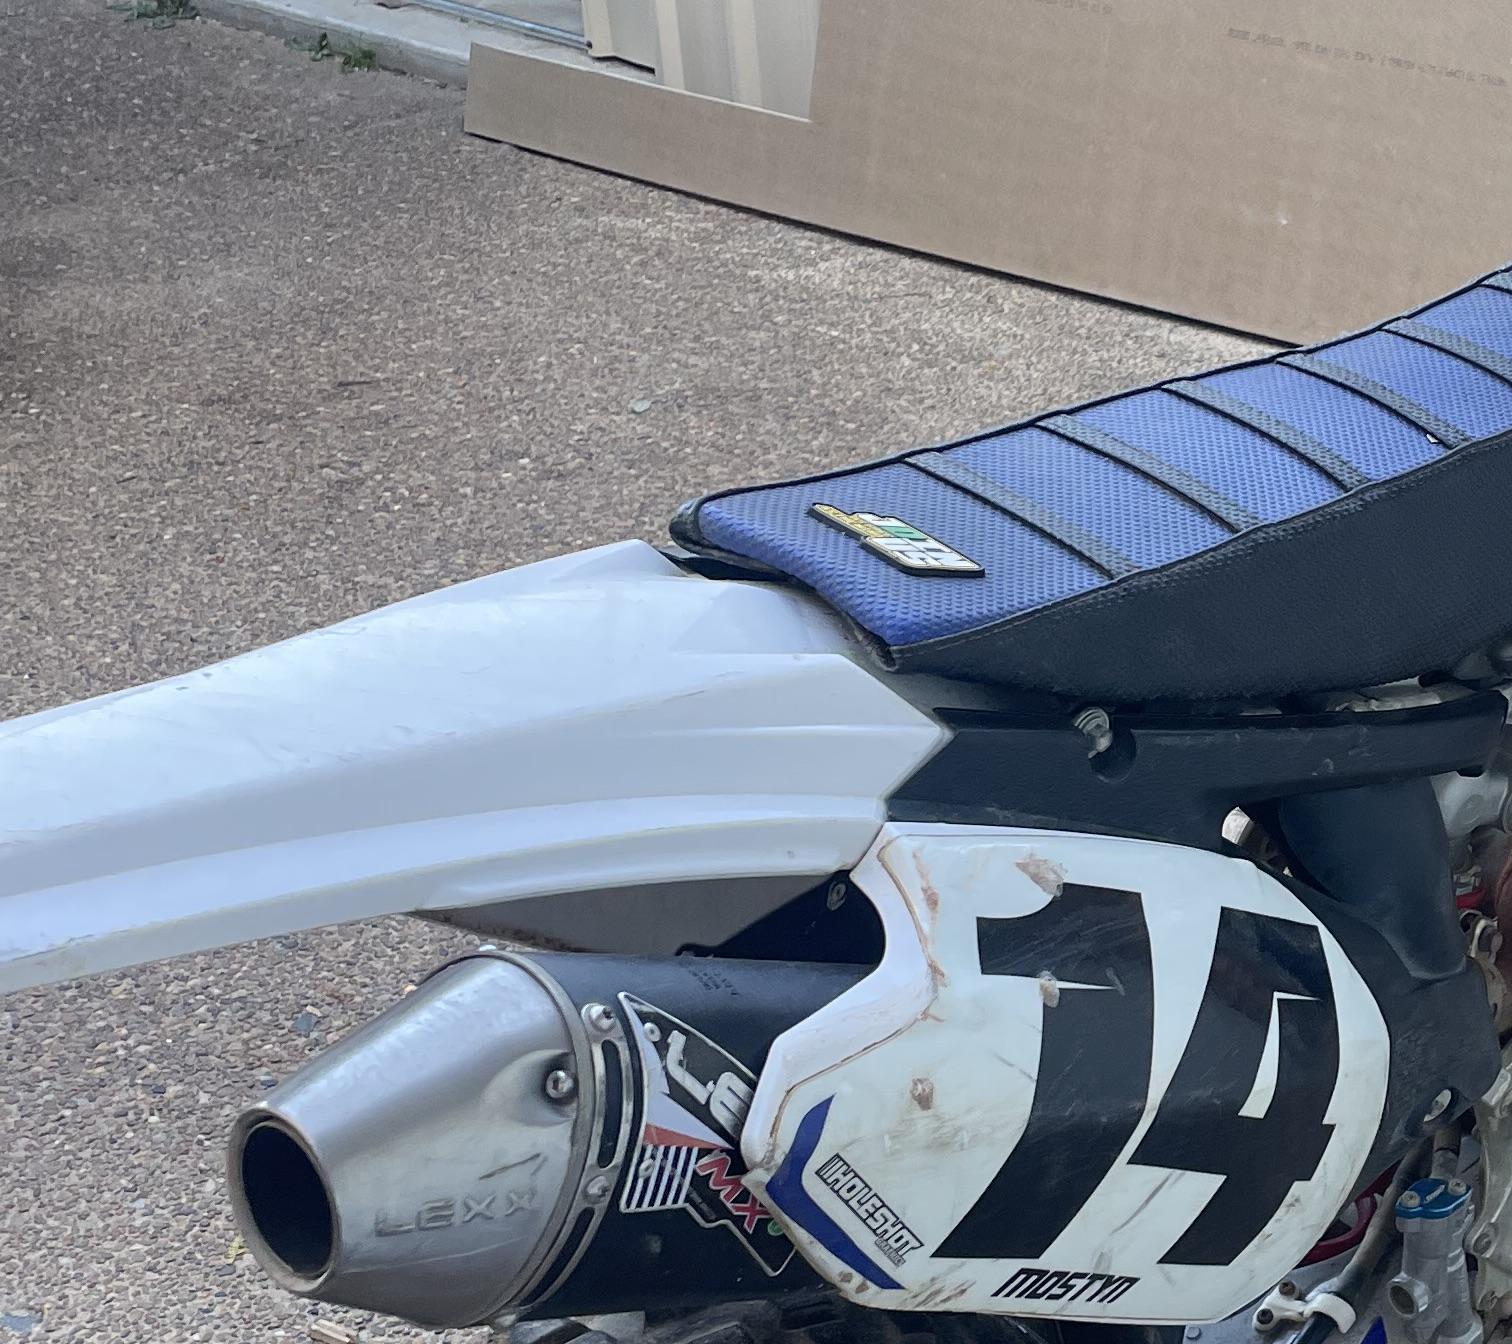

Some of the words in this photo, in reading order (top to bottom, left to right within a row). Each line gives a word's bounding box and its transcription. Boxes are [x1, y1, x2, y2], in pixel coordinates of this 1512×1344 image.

[930, 882, 1341, 1266] 14
[374, 1187, 537, 1237] LEXX
[815, 1153, 924, 1258] HOLESHOT
[991, 1268, 1140, 1305] MOSTYN
